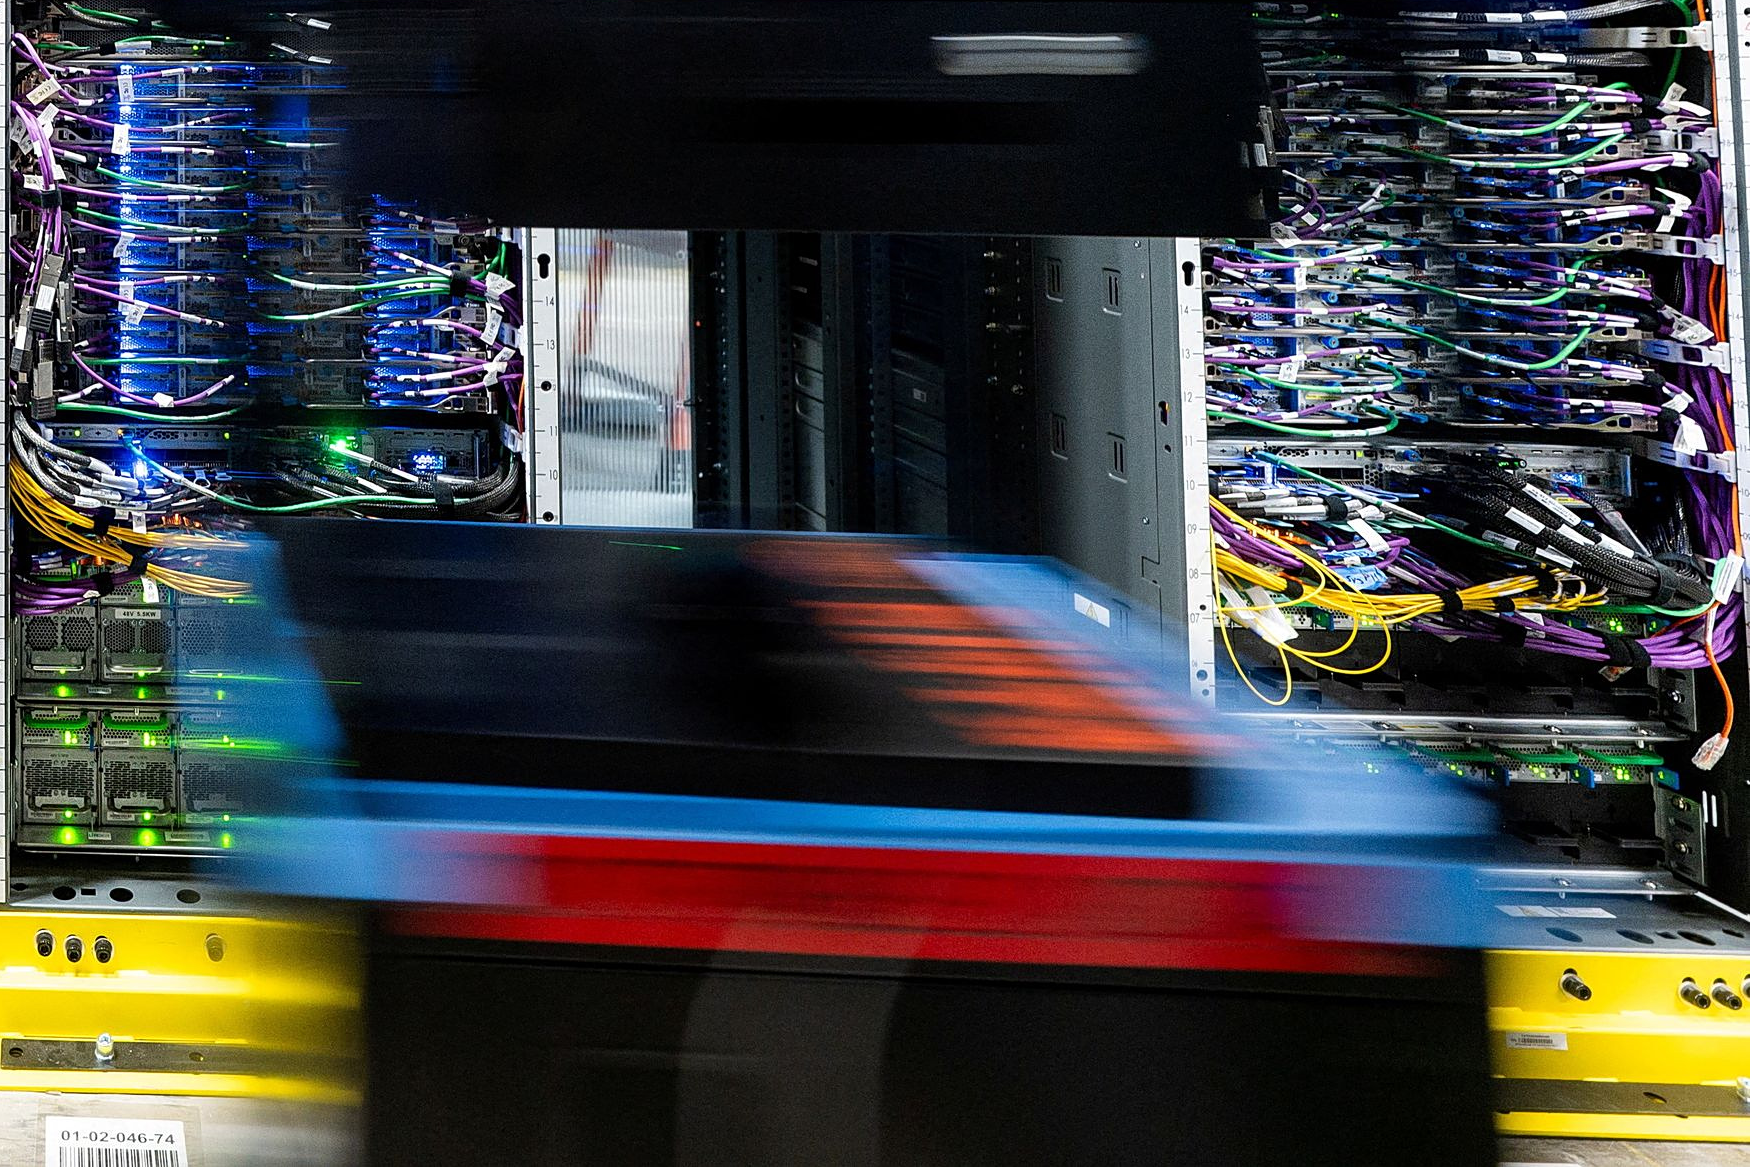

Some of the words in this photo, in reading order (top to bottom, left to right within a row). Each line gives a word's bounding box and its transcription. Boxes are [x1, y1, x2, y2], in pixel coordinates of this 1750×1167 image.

[1727, 225, 1736, 234] 16
[1728, 268, 1738, 277] 15
[546, 296, 554, 306] 14
[1180, 304, 1189, 314] 14
[1732, 312, 1740, 321] 14
[546, 339, 555, 350] 13
[1182, 348, 1190, 360] 13
[1183, 391, 1192, 403] 12
[550, 426, 558, 436] 11
[1184, 435, 1193, 447] 11
[549, 469, 558, 481] 10
[1185, 480, 1195, 490] 10
[1187, 523, 1197, 535] 09
[1188, 568, 1199, 580] 08
[1190, 612, 1200, 624] 07
[61, 1130, 175, 1145] 01-02-046-74
